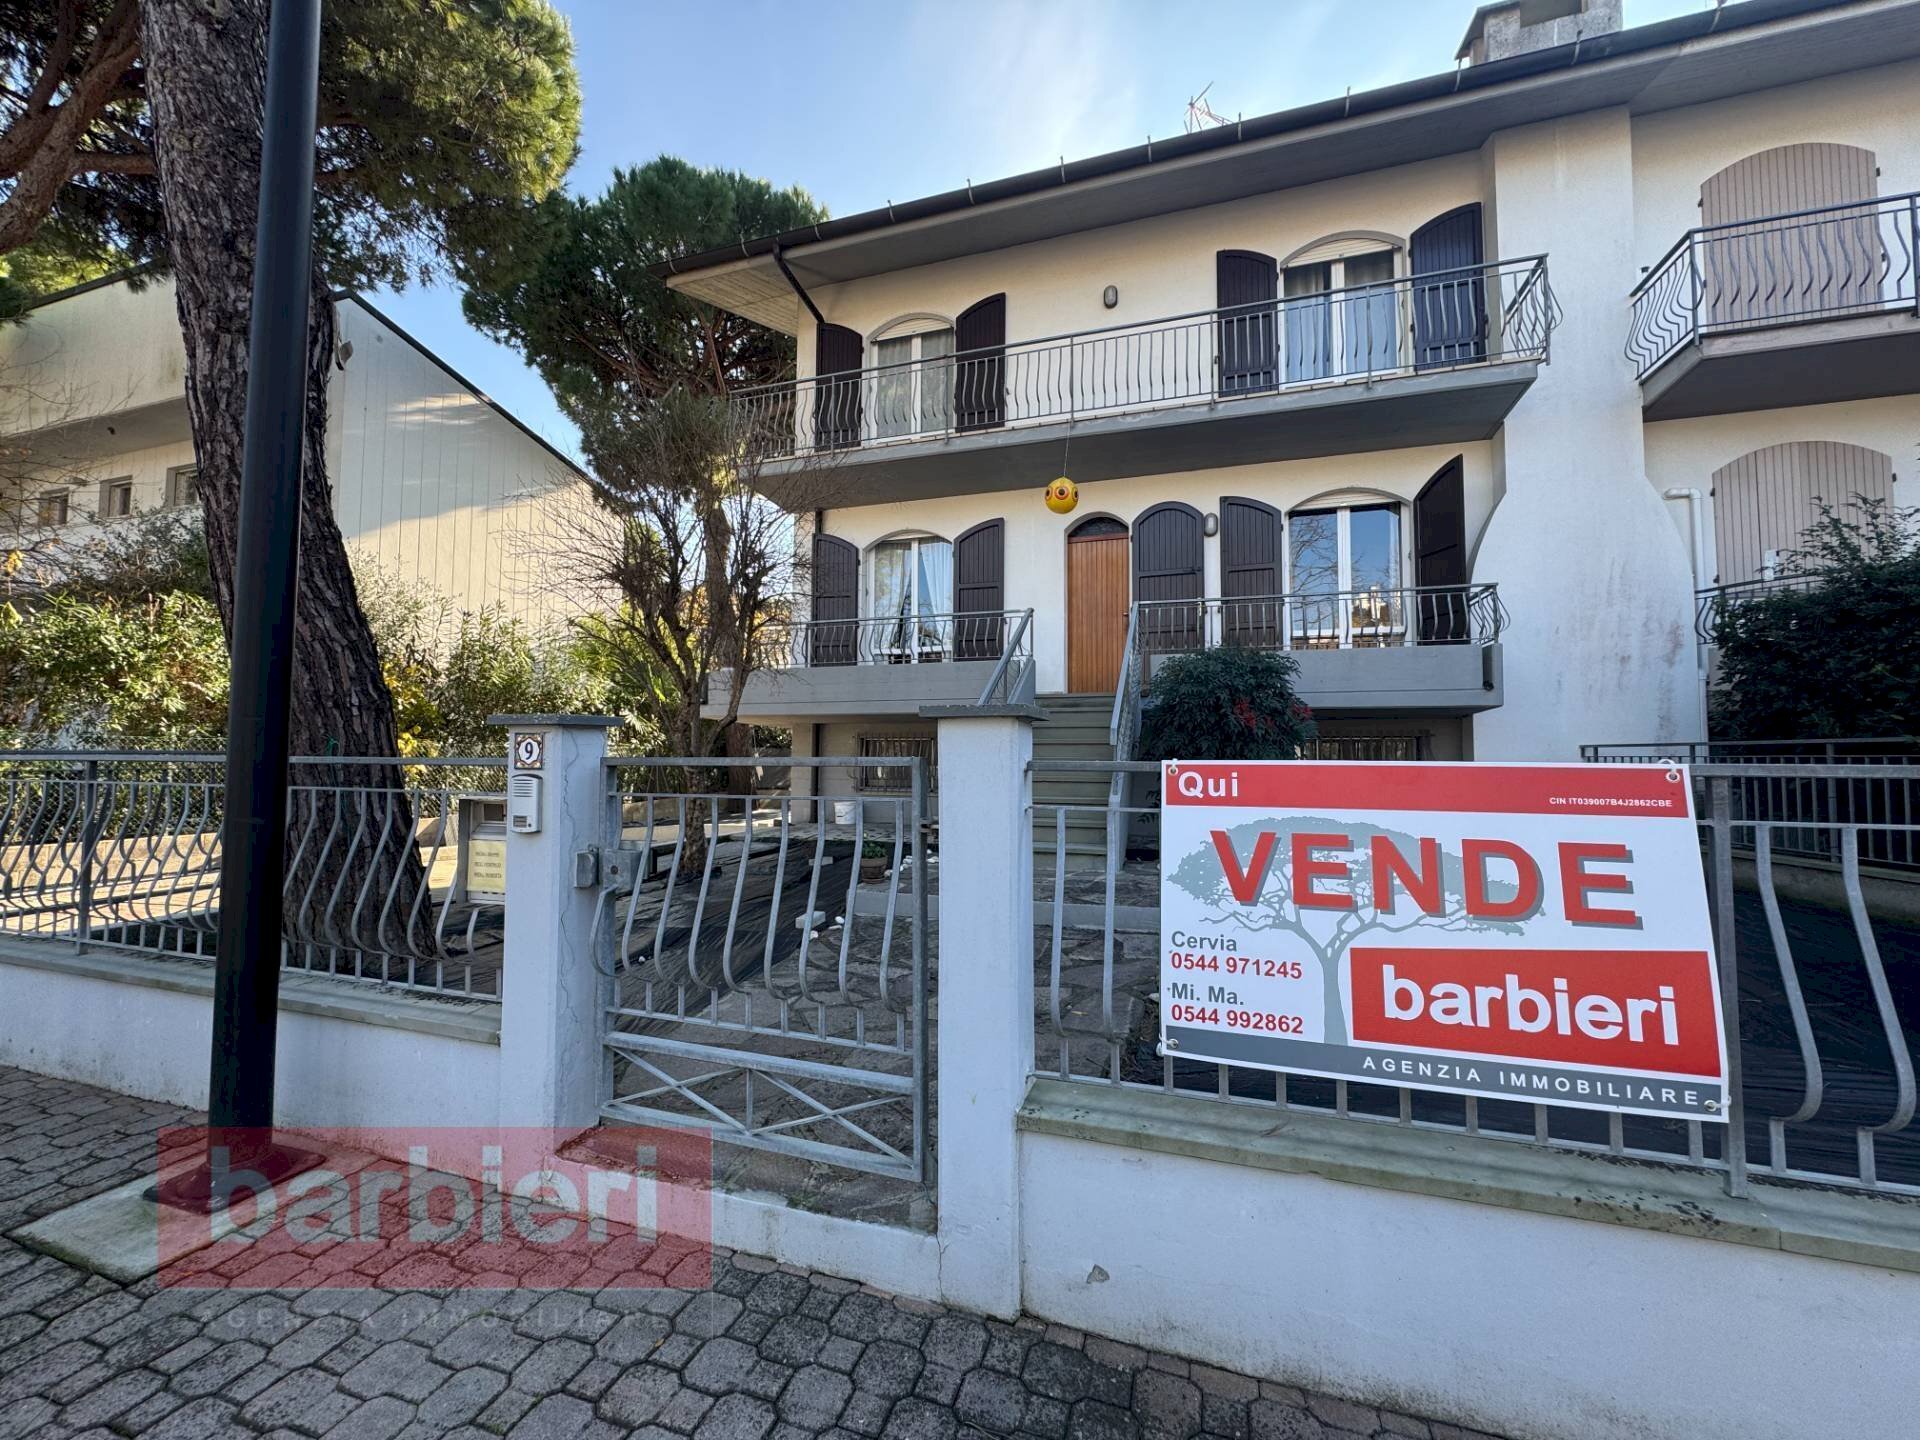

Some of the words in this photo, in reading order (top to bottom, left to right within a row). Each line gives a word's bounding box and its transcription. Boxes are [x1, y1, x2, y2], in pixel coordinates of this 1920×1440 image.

[524, 741, 534, 760] 9
[1178, 771, 1240, 802] Qui
[1549, 797, 1566, 805] CIN
[1210, 830, 1643, 929] VENDE
[1171, 931, 1239, 952] Cervia
[1170, 952, 1220, 973] 0544
[1226, 957, 1303, 980] 971245
[1171, 982, 1203, 1003] Mi.
[1208, 985, 1246, 1006] Ma.
[1382, 964, 1679, 1046] barbieri
[1171, 1003, 1220, 1025] 0544
[1226, 1009, 1304, 1034] 992862
[1362, 1056, 1482, 1083] AGENZIA
[1499, 1071, 1701, 1106] IMMOBILIARE
